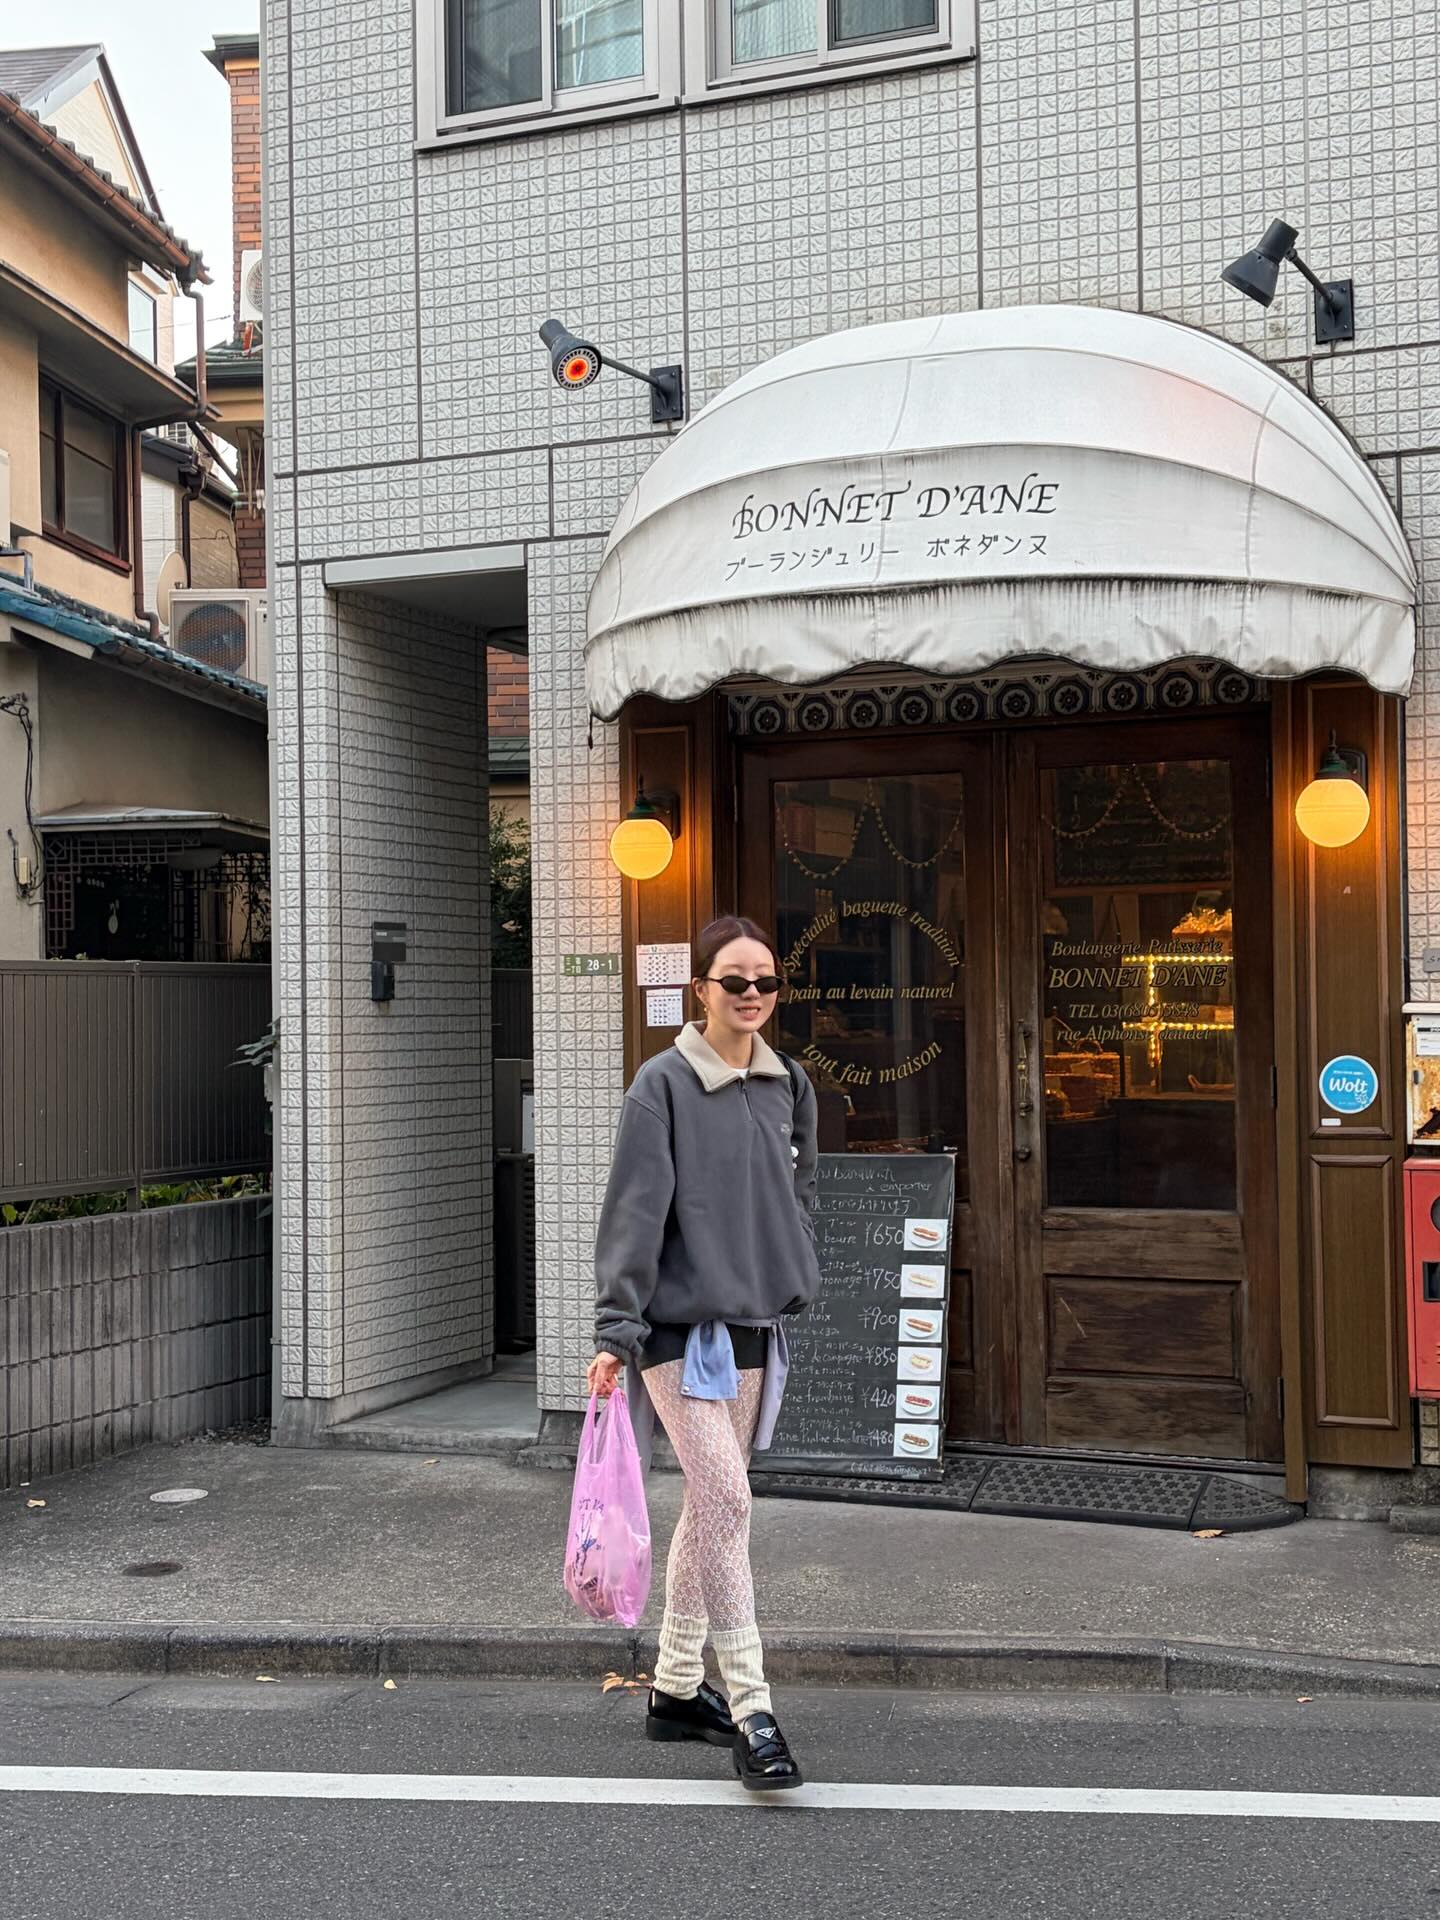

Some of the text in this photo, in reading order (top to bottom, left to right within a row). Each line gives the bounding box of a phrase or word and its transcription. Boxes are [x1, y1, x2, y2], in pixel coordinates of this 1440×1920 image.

[732, 472, 1060, 540] BONNET D'ANE
[725, 534, 1048, 582] ブーランジュリー ボネダンヌ
[842, 900, 908, 918] baguette
[909, 910, 961, 968] tradition
[1052, 941, 1141, 958] Boulangerie
[1049, 964, 1228, 989] BONNET D'ANE
[789, 982, 955, 1005] pain au levain naturel
[1068, 1004, 1099, 1018] TEL
[1056, 1029, 1082, 1041] rue
[802, 1040, 942, 1086] tout fait maison
[1329, 1077, 1368, 1093] Wolt
[865, 1221, 904, 1248] ¥650
[820, 1265, 901, 1290] romage ¥750
[857, 1304, 898, 1331] ¥900
[864, 1345, 898, 1367] ¥850
[860, 1385, 896, 1409] ¥420
